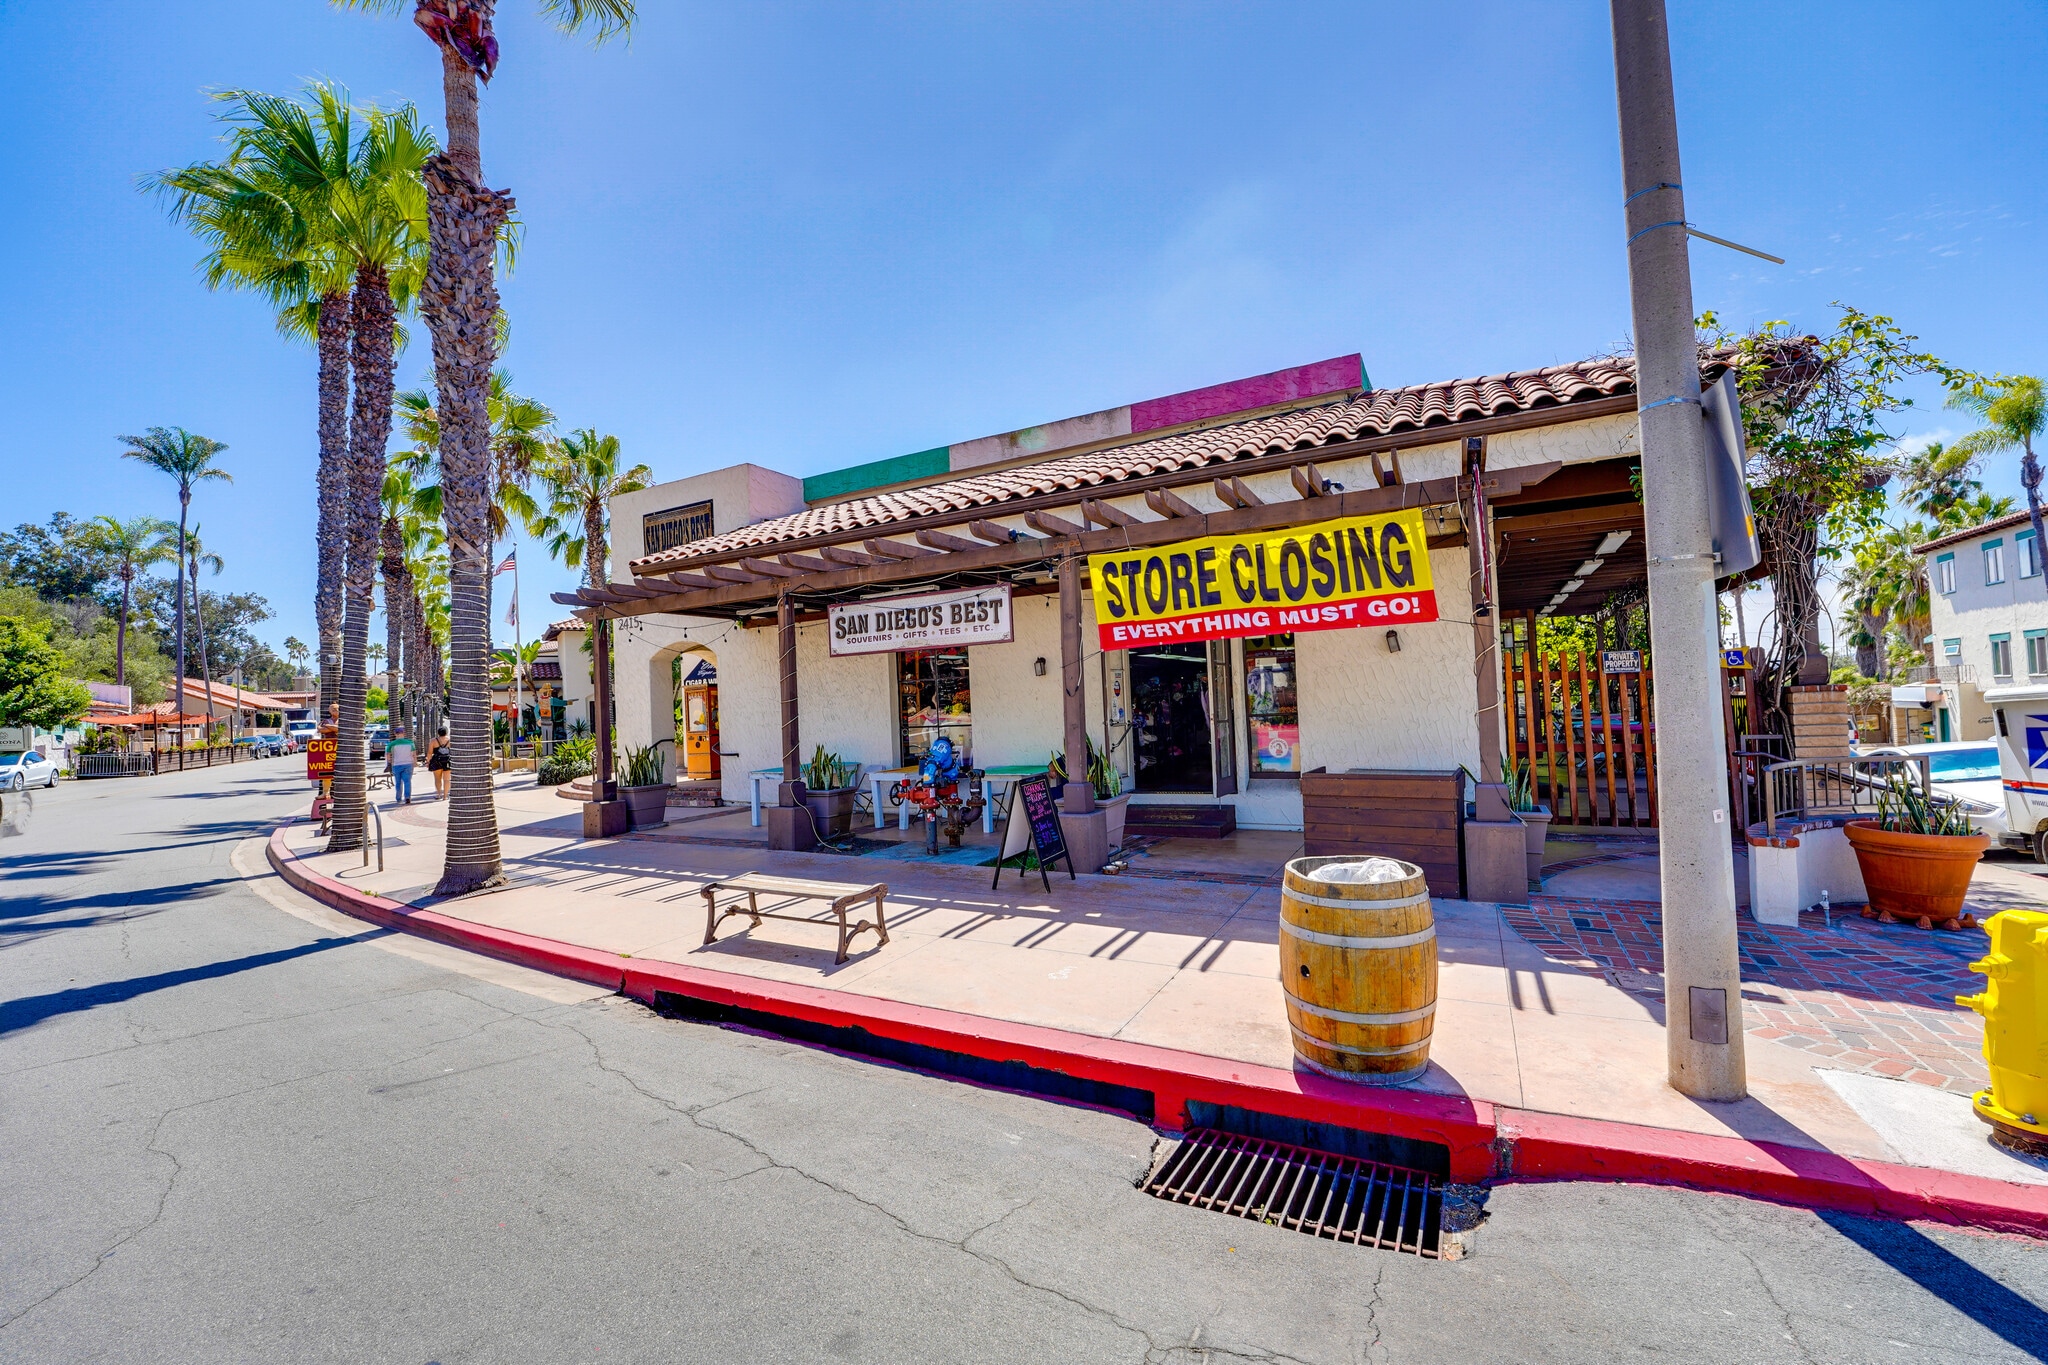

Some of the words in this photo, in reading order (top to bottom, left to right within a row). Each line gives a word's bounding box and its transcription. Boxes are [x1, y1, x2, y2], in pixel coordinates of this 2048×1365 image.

[1101, 546, 1222, 619] STORE
[1229, 521, 1416, 604] CLOSING
[618, 616, 640, 631] 2415
[835, 613, 869, 640] SAN
[875, 604, 943, 633] DIEGO'S
[950, 597, 1003, 626] BEST
[1112, 610, 1270, 642] EVERYTHING
[1279, 603, 1358, 626] MUST
[1366, 596, 1421, 617] GO!
[846, 633, 893, 645] SOUVENIRS
[902, 630, 928, 640] GIFTS
[938, 626, 961, 636] TEES
[972, 624, 994, 633] ETC.
[1605, 660, 1639, 668] PROPERTY
[1608, 652, 1635, 661] PRIVATE
